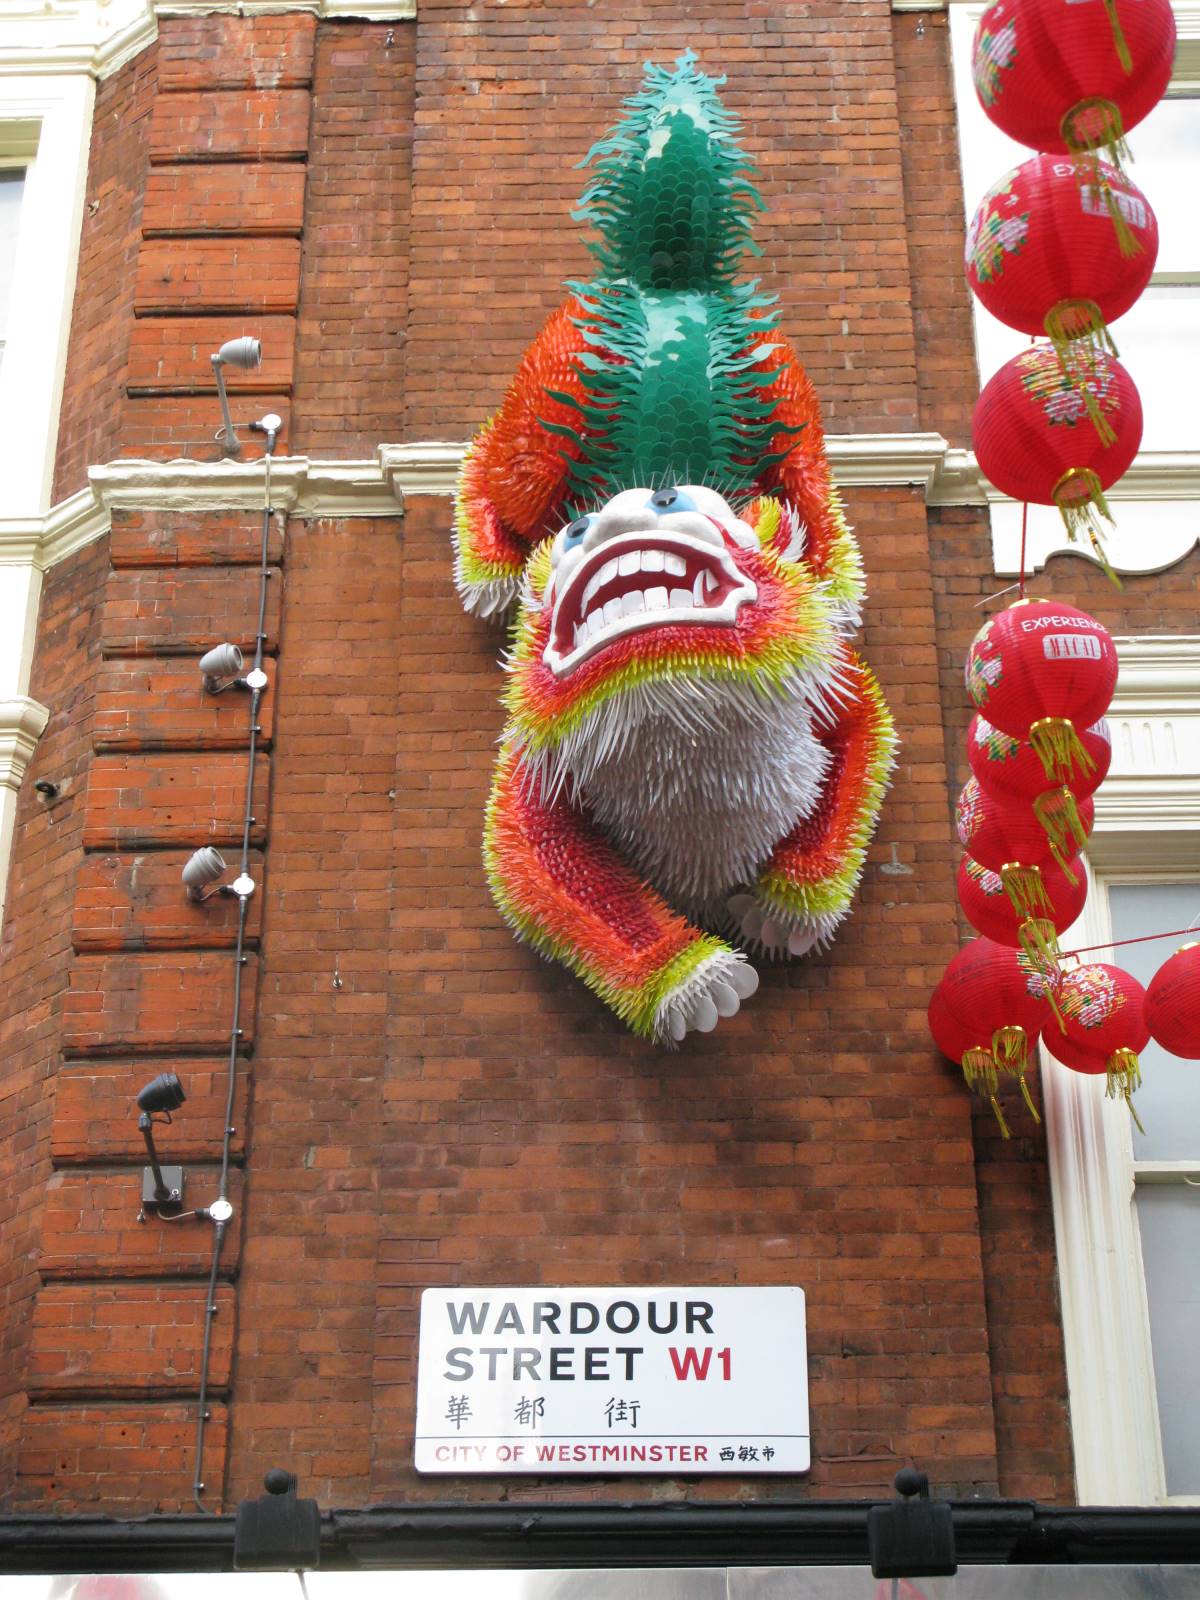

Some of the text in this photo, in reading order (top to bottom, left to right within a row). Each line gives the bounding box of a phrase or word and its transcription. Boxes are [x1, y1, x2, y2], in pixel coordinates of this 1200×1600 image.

[446, 1301, 714, 1335] WARDOUR
[443, 1347, 732, 1381] STREET W1
[444, 1395, 641, 1430] 華都街
[435, 1445, 708, 1462] CITY OF WESTMINSTER
[719, 1445, 775, 1462] 西敏市
